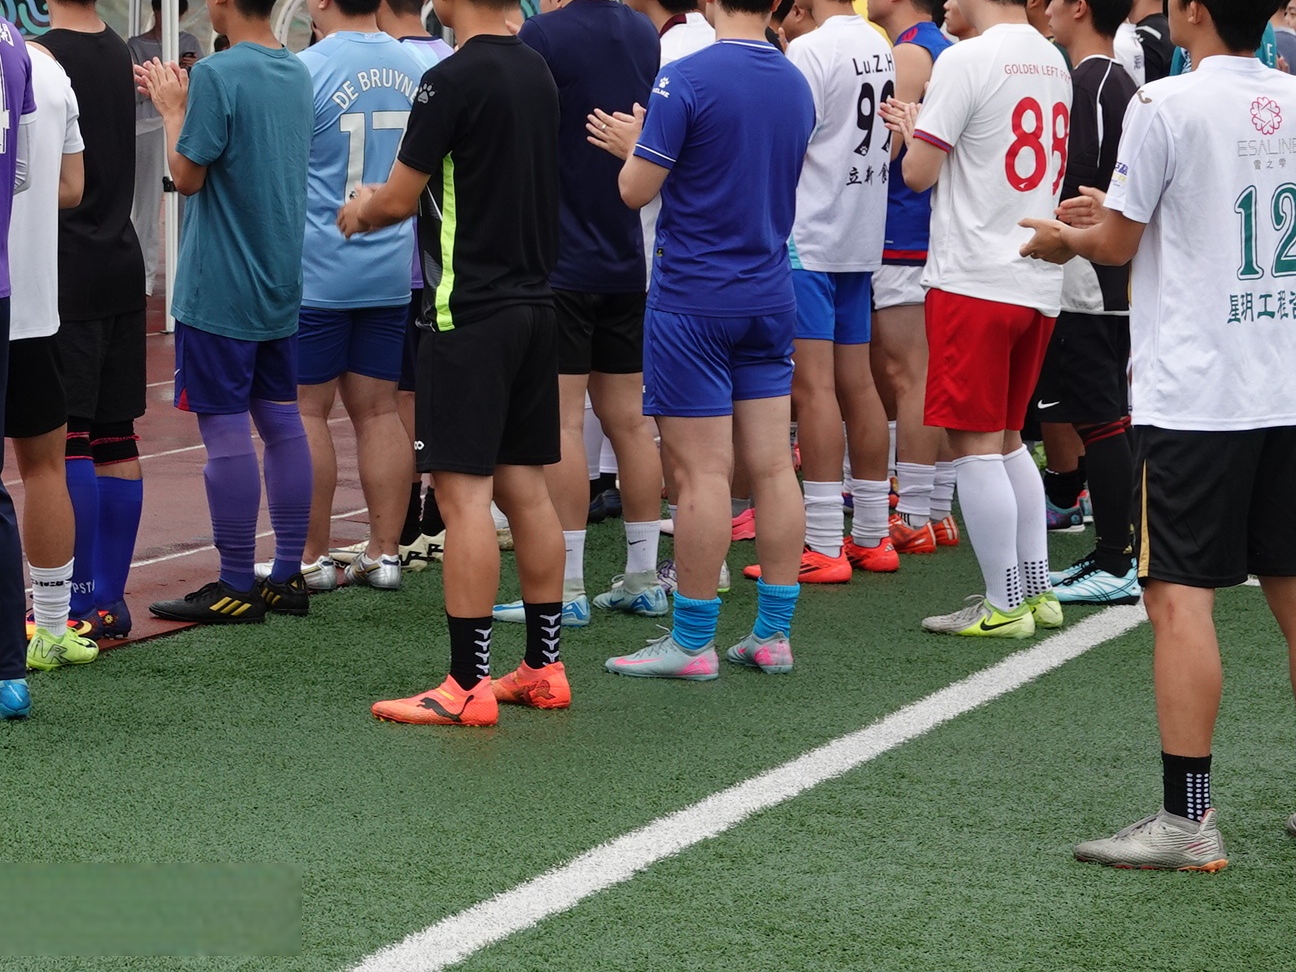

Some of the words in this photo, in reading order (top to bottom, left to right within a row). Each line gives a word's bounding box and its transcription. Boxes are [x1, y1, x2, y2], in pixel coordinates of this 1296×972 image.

[1004, 64, 1039, 75] GOLDEN
[1041, 65, 1059, 78] LEFT
[332, 81, 359, 110] DE
[1234, 182, 1296, 281] 12
